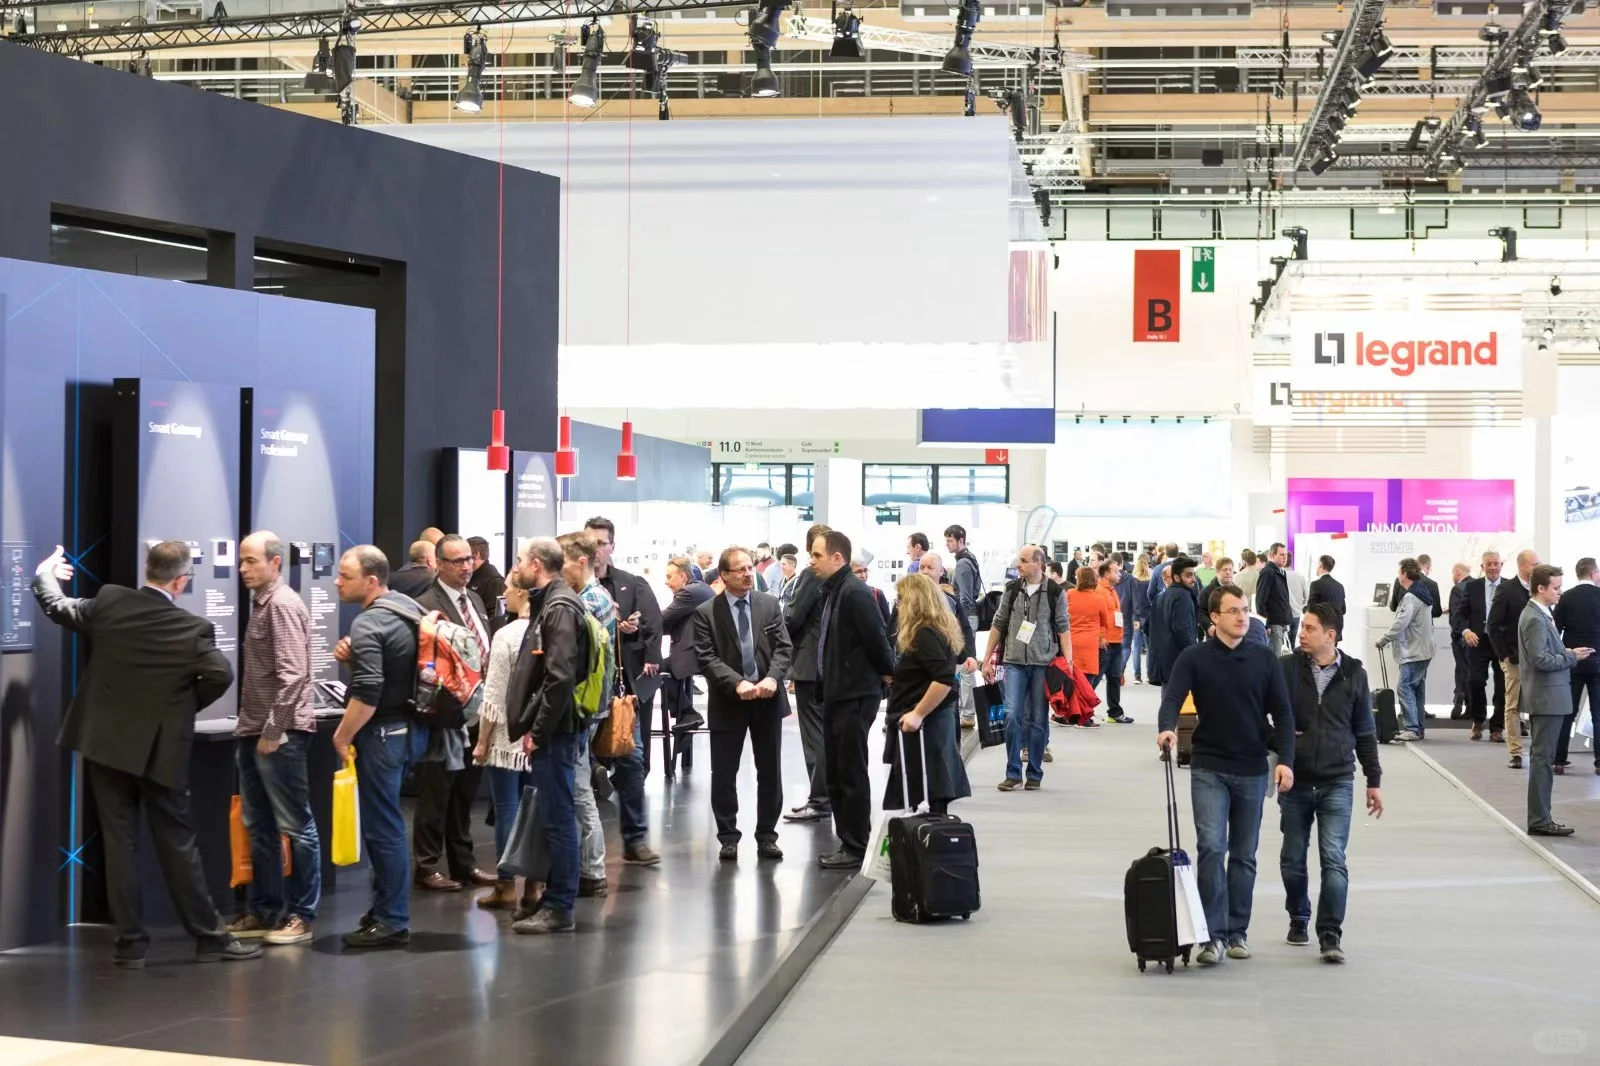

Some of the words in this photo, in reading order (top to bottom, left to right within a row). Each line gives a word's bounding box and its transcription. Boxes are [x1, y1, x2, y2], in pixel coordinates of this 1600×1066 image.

[1147, 298, 1172, 332] B
[1356, 331, 1498, 377] legrand
[148, 421, 171, 434] Smart
[719, 441, 741, 453] 11.0
[1365, 522, 1459, 533] INNOVATION
